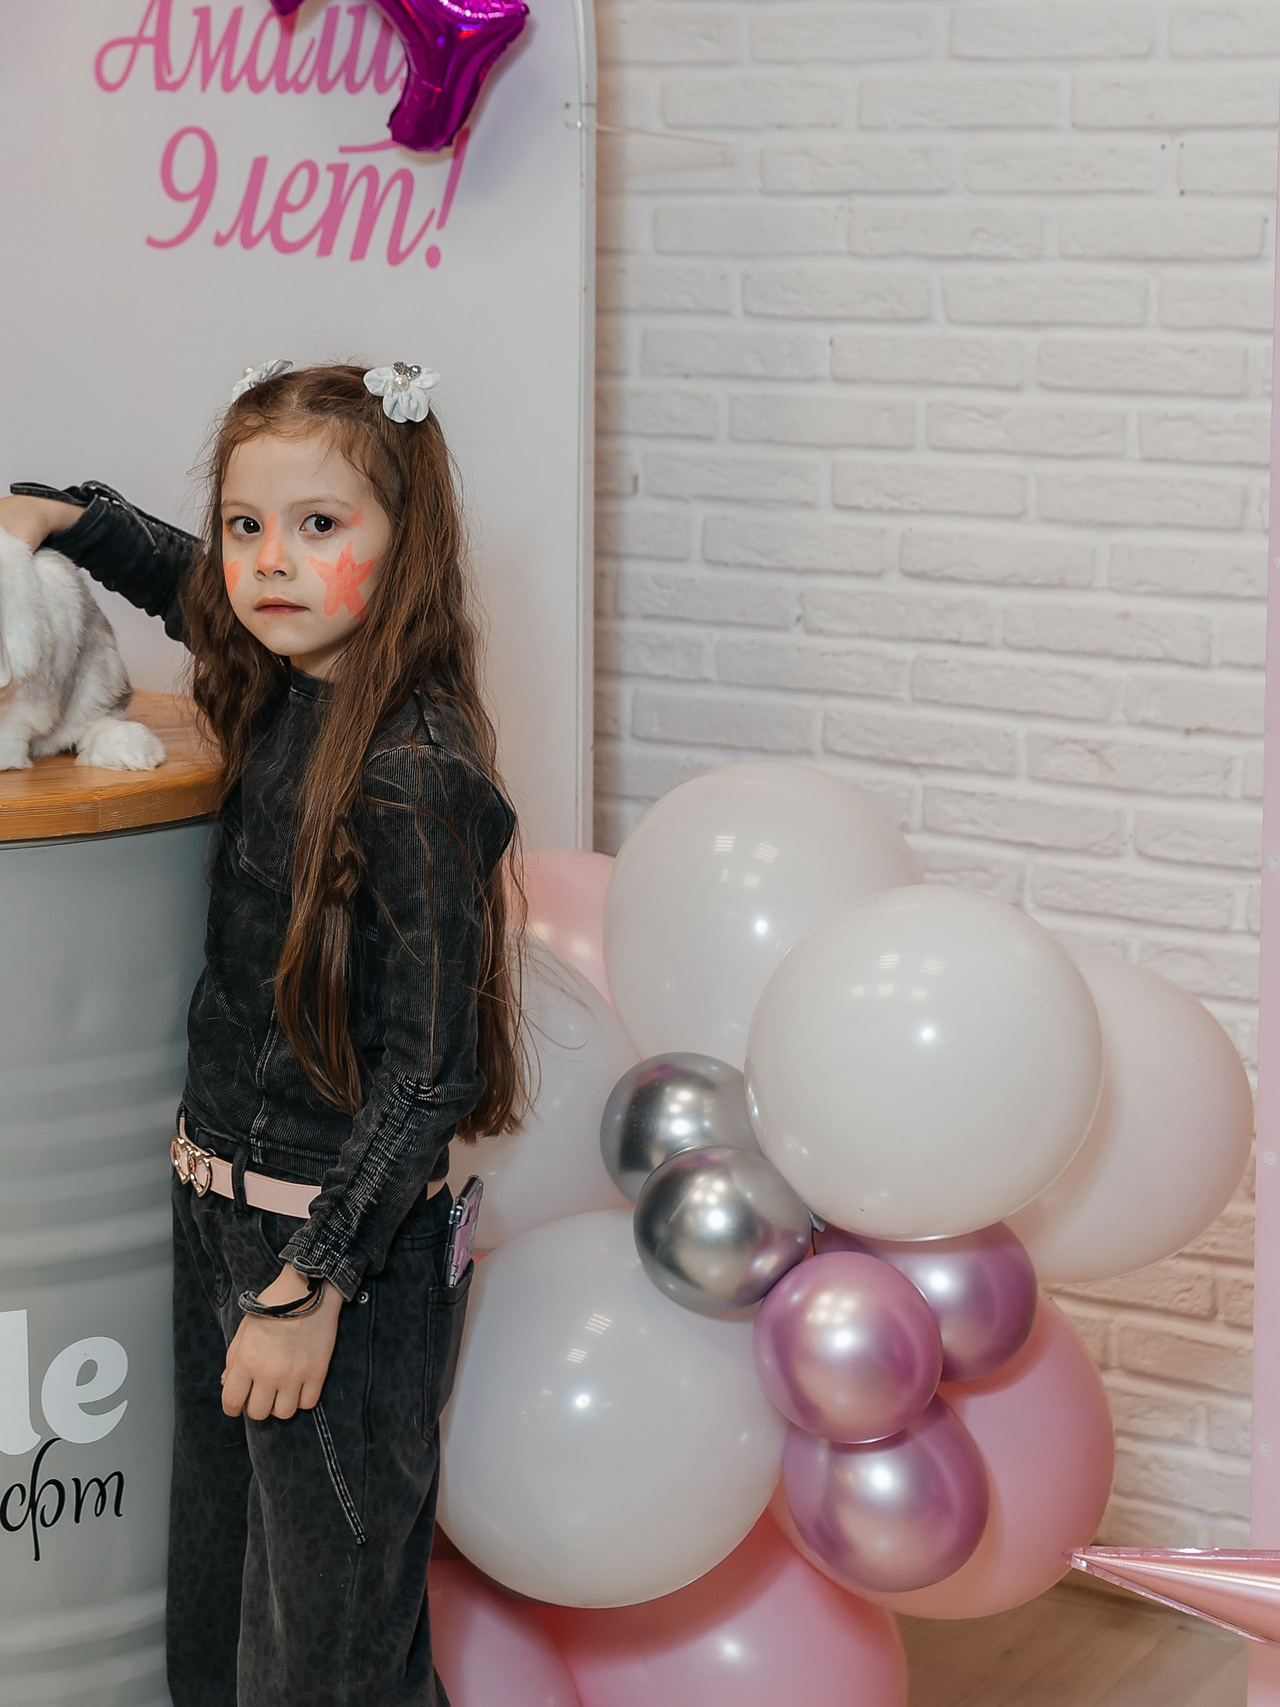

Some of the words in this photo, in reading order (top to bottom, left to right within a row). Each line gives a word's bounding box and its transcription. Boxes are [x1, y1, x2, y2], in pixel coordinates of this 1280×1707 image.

[95, 0, 406, 94] Амали
[145, 126, 218, 249] 9
[213, 127, 470, 268] лет!
